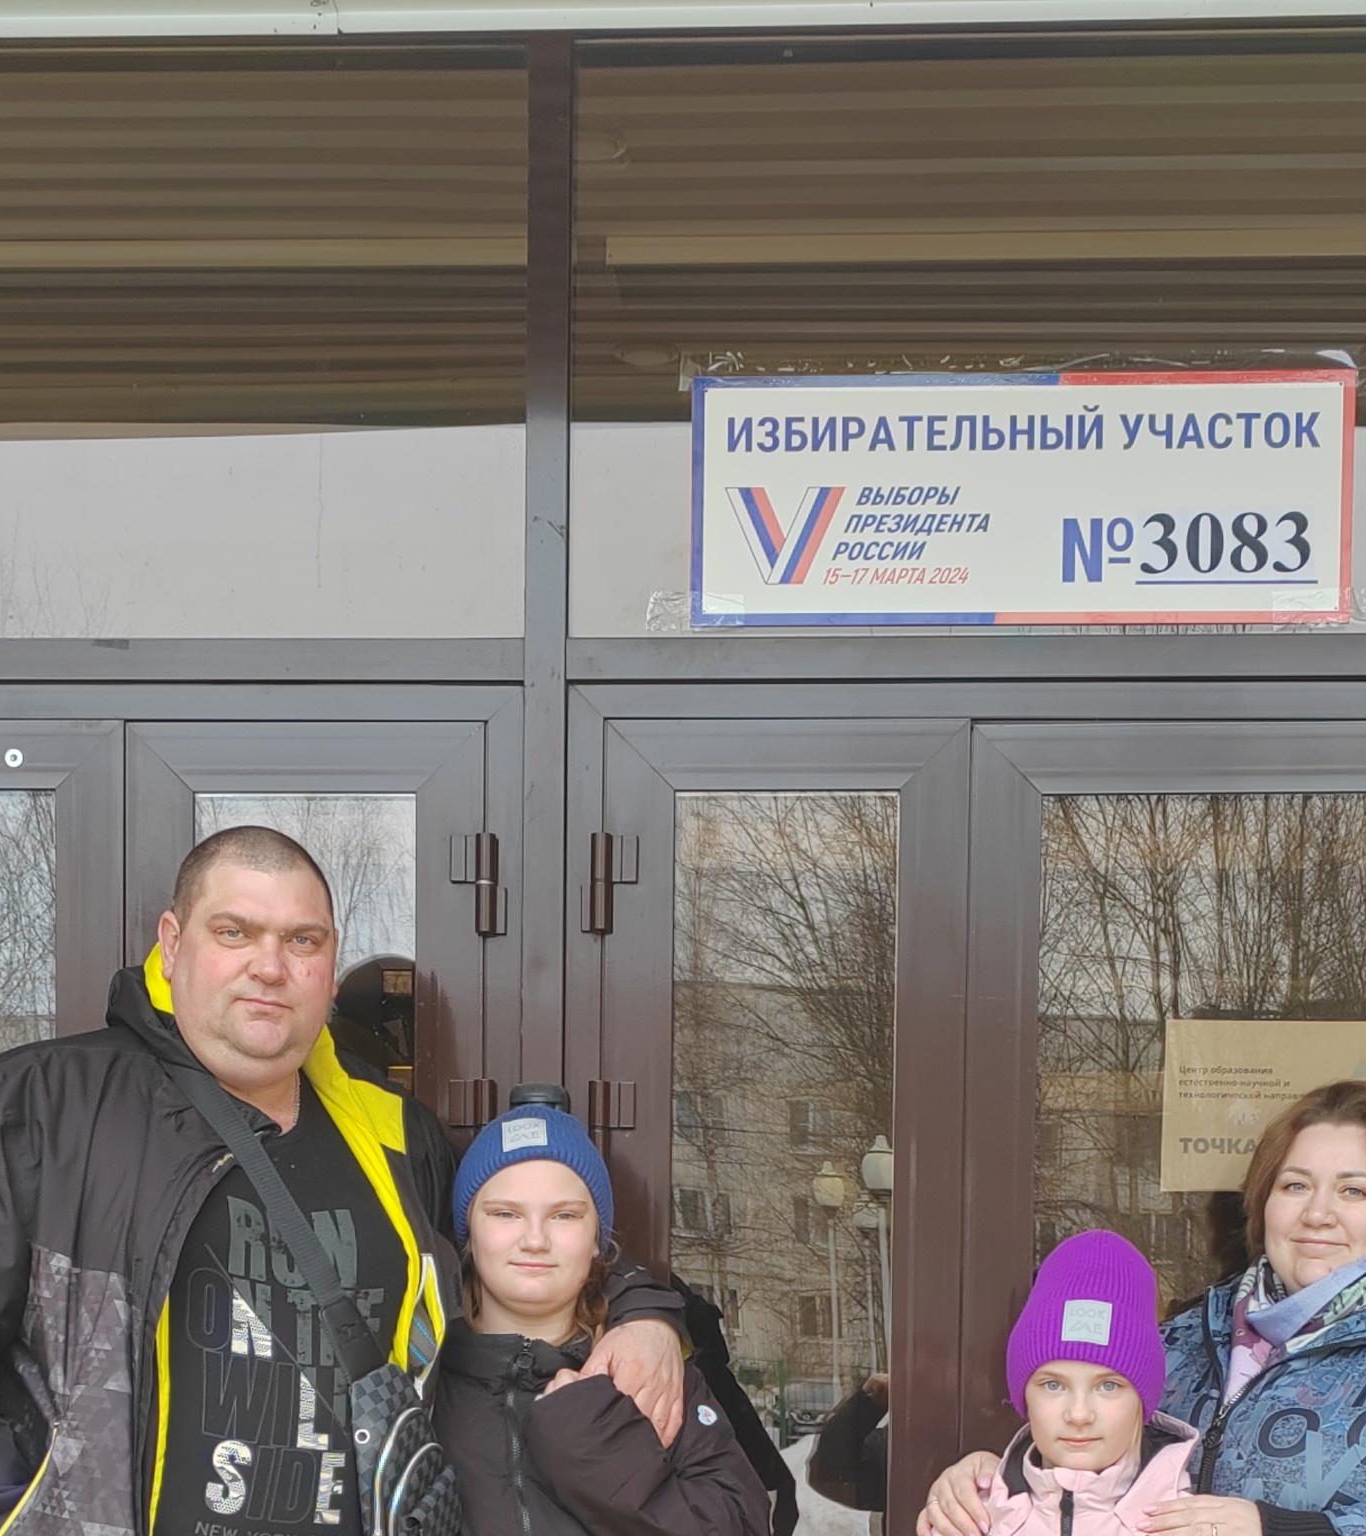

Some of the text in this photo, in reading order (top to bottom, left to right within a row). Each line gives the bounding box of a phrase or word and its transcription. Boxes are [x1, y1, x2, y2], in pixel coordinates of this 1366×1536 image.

[726, 405, 1321, 453] ИЗБИРАТЕЛЬНЫЙ УЧАСТОК
[855, 485, 961, 506] ВЫБОРЫ
[843, 513, 990, 536] ПРЕЗИДЕНТА
[831, 541, 927, 561] РОССИИ
[869, 568, 927, 585] МАРТА
[928, 566, 969, 585] 2024
[1178, 1065, 1273, 1076] Центр образования
[1178, 1090, 1261, 1100] технологической
[1179, 1137, 1259, 1155] ТОЧКА
[187, 1268, 272, 1358] ON
[1069, 1307, 1106, 1320] LOOK
[204, 1439, 346, 1525] SIDE
